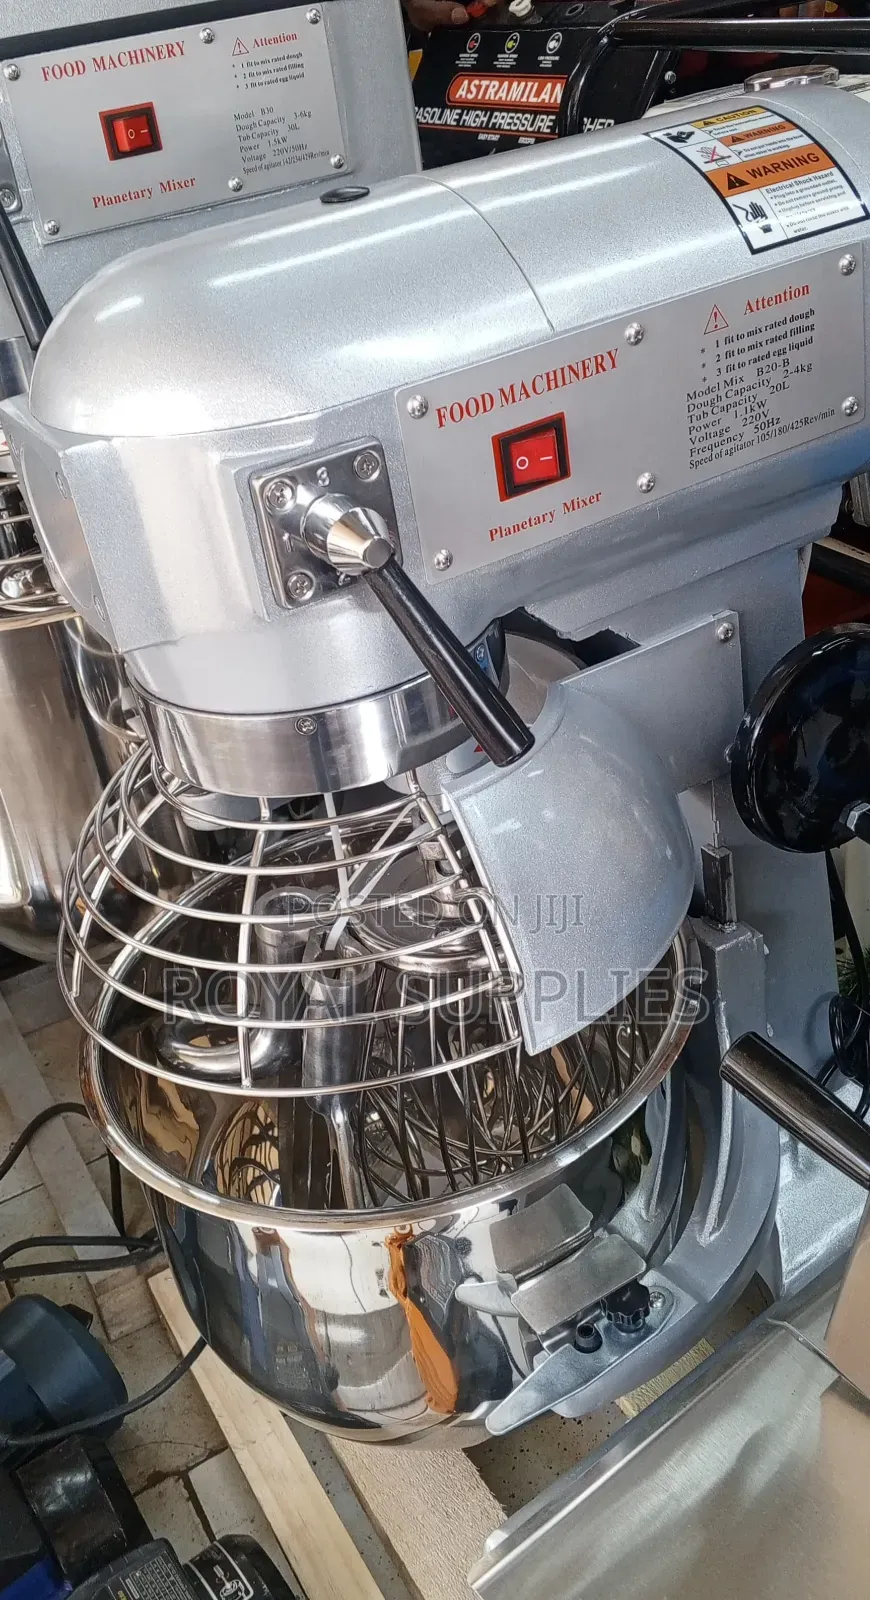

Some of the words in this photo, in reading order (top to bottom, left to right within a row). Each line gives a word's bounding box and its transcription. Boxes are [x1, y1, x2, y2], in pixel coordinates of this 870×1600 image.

[253, 32, 298, 48] Attention
[42, 60, 86, 82] FOOD
[92, 40, 185, 72] MACHINERY
[286, 52, 302, 60] dough
[264, 77, 278, 86] rated
[288, 72, 305, 80] liquid
[234, 110, 254, 121] Model
[260, 106, 274, 115] B30
[236, 121, 257, 132] Dough
[258, 116, 285, 127] Capacity
[294, 110, 312, 119] 3-6kg
[460, 110, 490, 128] HIGH
[489, 112, 556, 133] PRESSURE
[716, 109, 757, 122] CAUTION
[238, 133, 250, 142] Tub
[252, 128, 279, 140] Capacity
[287, 123, 300, 132] 30L
[240, 144, 259, 153] Power
[268, 136, 288, 148] 1.5kW
[744, 124, 786, 138] WARNING
[242, 153, 266, 164] Voltage
[243, 165, 257, 175] Speed
[258, 162, 264, 171] of
[746, 152, 820, 179] WARNING
[92, 187, 153, 208] Planetary
[159, 178, 196, 194] Mixer
[765, 182, 794, 194] Electrical
[794, 178, 813, 186] Shock
[813, 171, 834, 181] Hazard
[744, 284, 810, 315] Attention
[716, 340, 719, 348] 1
[724, 335, 734, 346] fit
[736, 332, 745, 341] to
[747, 326, 763, 338] mix
[764, 316, 787, 332] rated
[789, 308, 815, 323] dough
[716, 354, 721, 363] 2
[725, 350, 735, 360] fit
[737, 347, 746, 355] to
[747, 340, 763, 352] mix
[765, 330, 788, 345] rated
[790, 323, 815, 337] filling
[716, 368, 721, 376] 3
[726, 363, 736, 374] fit
[738, 361, 746, 369] to
[748, 350, 770, 366] rated
[772, 347, 787, 358] egg
[788, 336, 813, 353] liquid
[435, 392, 495, 429] FOOD
[498, 348, 619, 407] MACHINERY
[686, 383, 720, 402] Model
[723, 375, 744, 392] Mix
[756, 358, 790, 377] B20-B
[687, 394, 722, 414] Dough
[725, 376, 772, 400] Capacity
[783, 362, 813, 379] 2-4kg
[687, 408, 708, 424] Tub
[711, 393, 758, 416] Capacity
[769, 381, 790, 395] 20L
[688, 417, 722, 435] Power
[734, 399, 768, 419] 1.1kW
[689, 427, 731, 446] Voltage
[742, 409, 770, 427] 220V
[689, 453, 713, 470] Speed
[715, 450, 724, 459] of
[724, 438, 754, 456] agitator
[756, 408, 835, 444] 105/180/425Rev/min
[690, 431, 745, 458] Frequency
[754, 416, 782, 434] 50Hz
[488, 509, 556, 542] Planetary
[562, 492, 602, 515] Mixer
